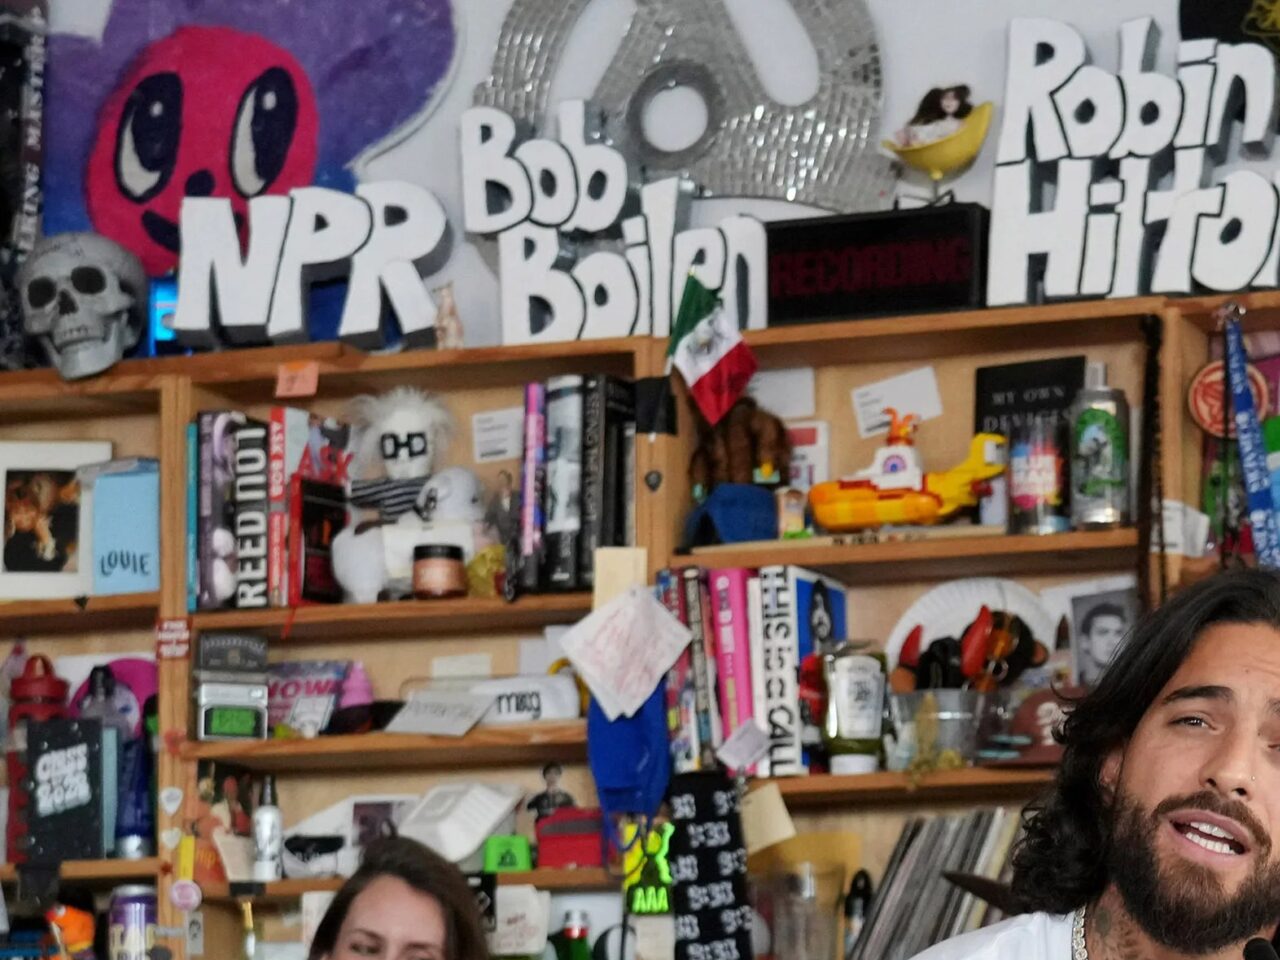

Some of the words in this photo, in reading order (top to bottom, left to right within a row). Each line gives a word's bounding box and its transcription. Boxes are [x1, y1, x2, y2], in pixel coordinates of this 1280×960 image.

[995, 15, 1278, 165] Robin
[461, 100, 628, 235] Bob
[174, 180, 450, 340] NPR
[500, 176, 768, 345] Boilen
[772, 237, 974, 297] RECORDING
[236, 510, 268, 608] REED
